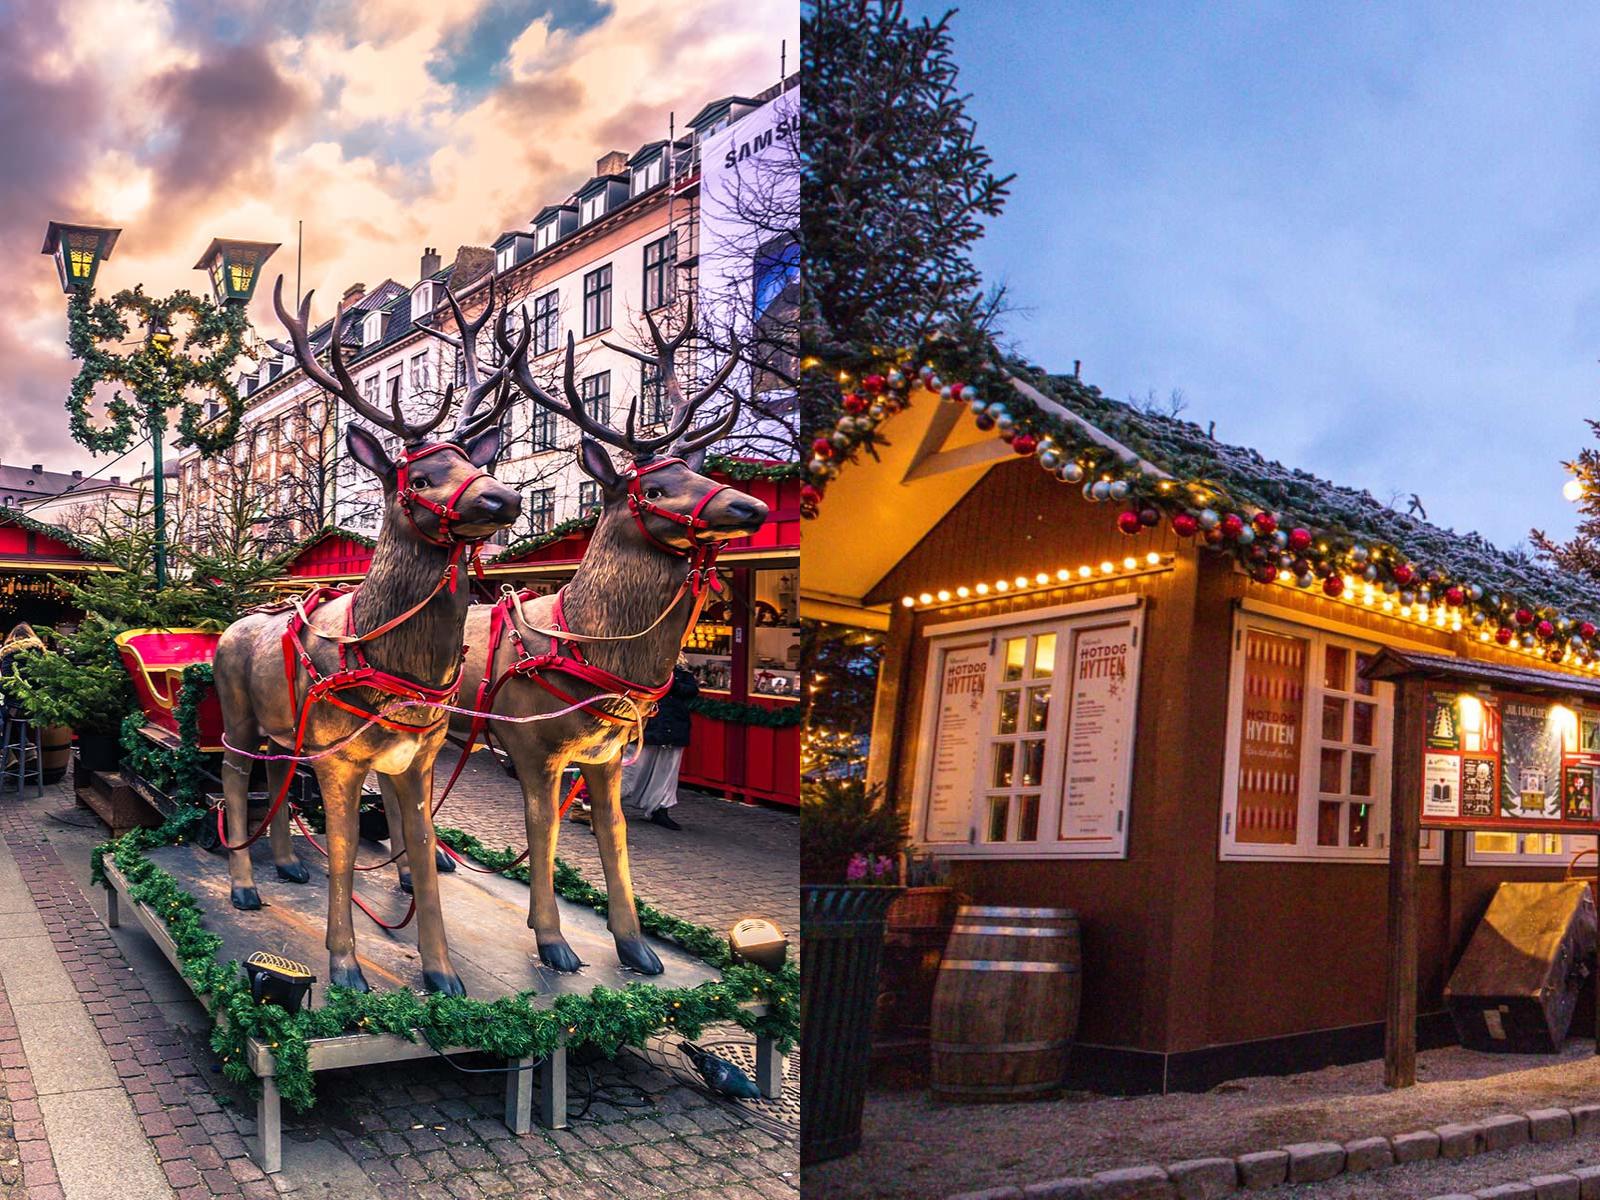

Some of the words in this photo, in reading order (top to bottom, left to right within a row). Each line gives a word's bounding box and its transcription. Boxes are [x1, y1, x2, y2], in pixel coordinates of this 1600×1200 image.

[1080, 643, 1127, 660] HOTDOG
[948, 662, 987, 676] HOTDOG
[1079, 655, 1125, 680] HYTTEN
[946, 673, 986, 695] HYTTEN
[1246, 709, 1296, 725] HOTDOG
[1246, 719, 1295, 745] HYTTEN
